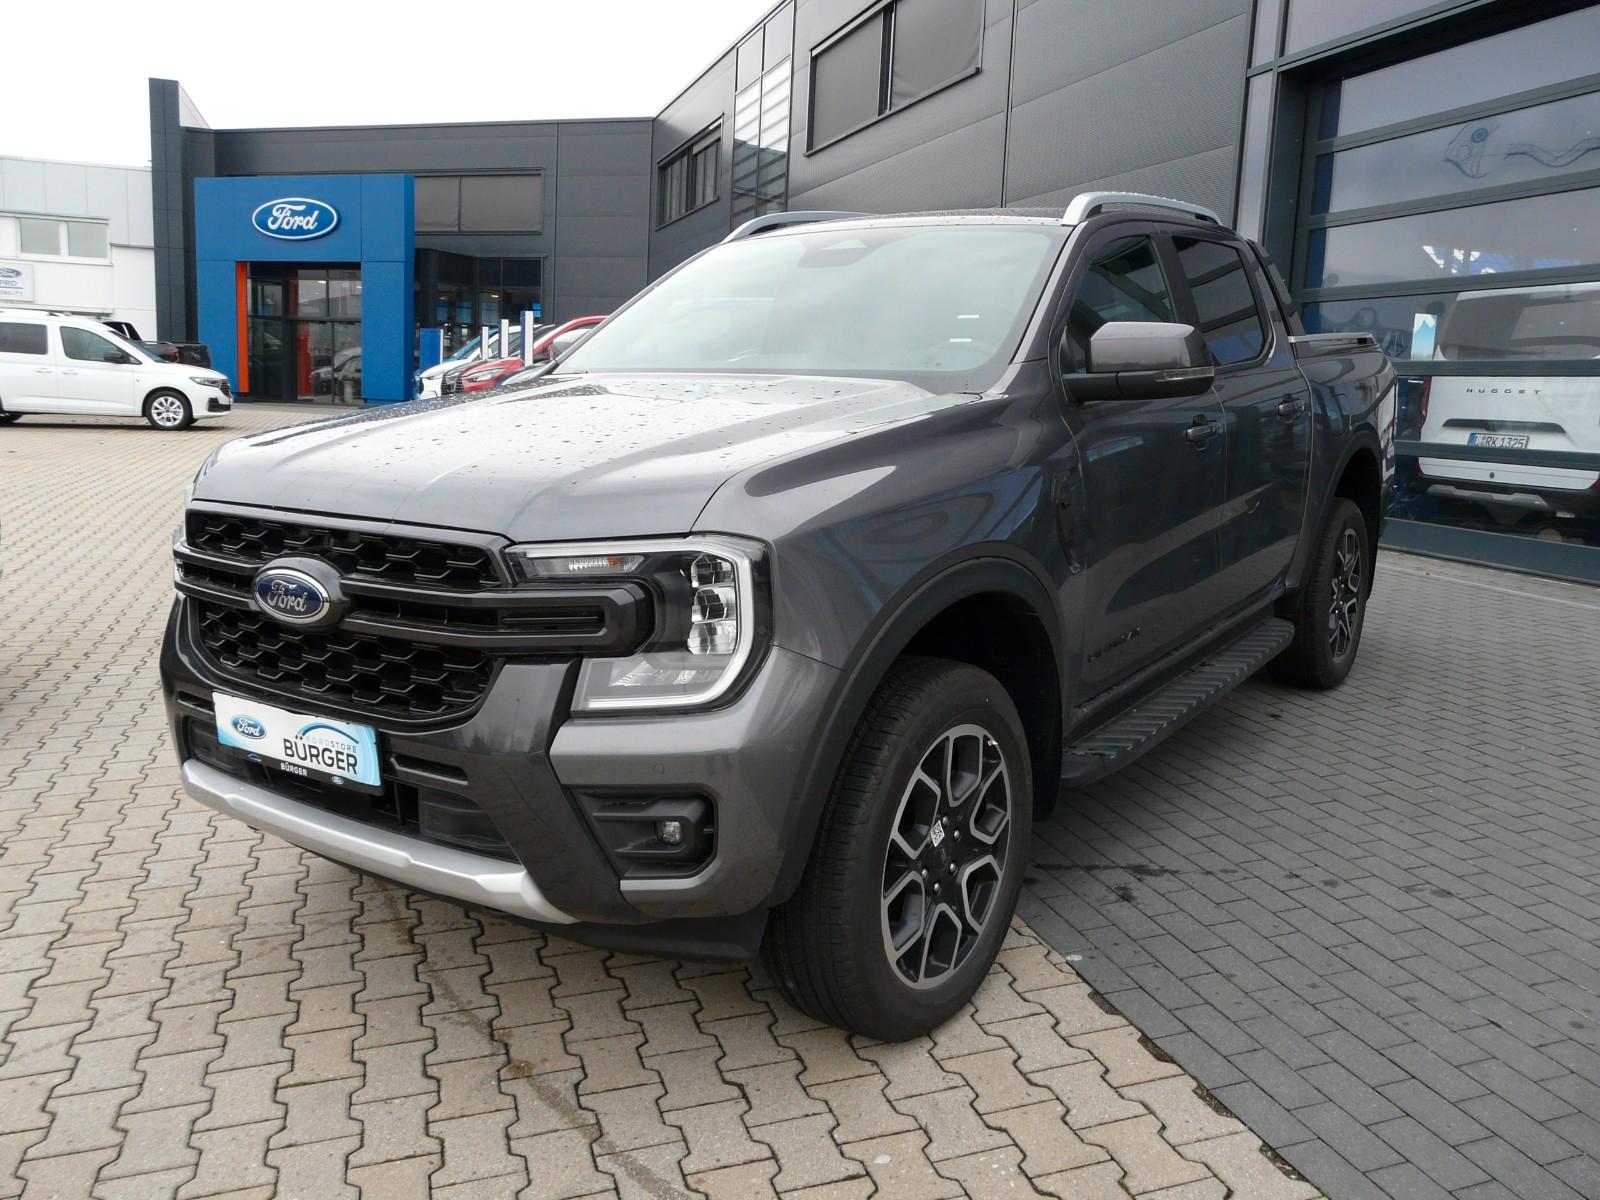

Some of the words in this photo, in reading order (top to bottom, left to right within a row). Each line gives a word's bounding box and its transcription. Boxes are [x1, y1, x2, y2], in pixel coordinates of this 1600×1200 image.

[268, 204, 319, 230] Ford
[267, 579, 308, 612] Ford
[236, 717, 261, 737] Ford
[283, 734, 358, 775] BÜRGER
[280, 761, 308, 777] BÜRGER
